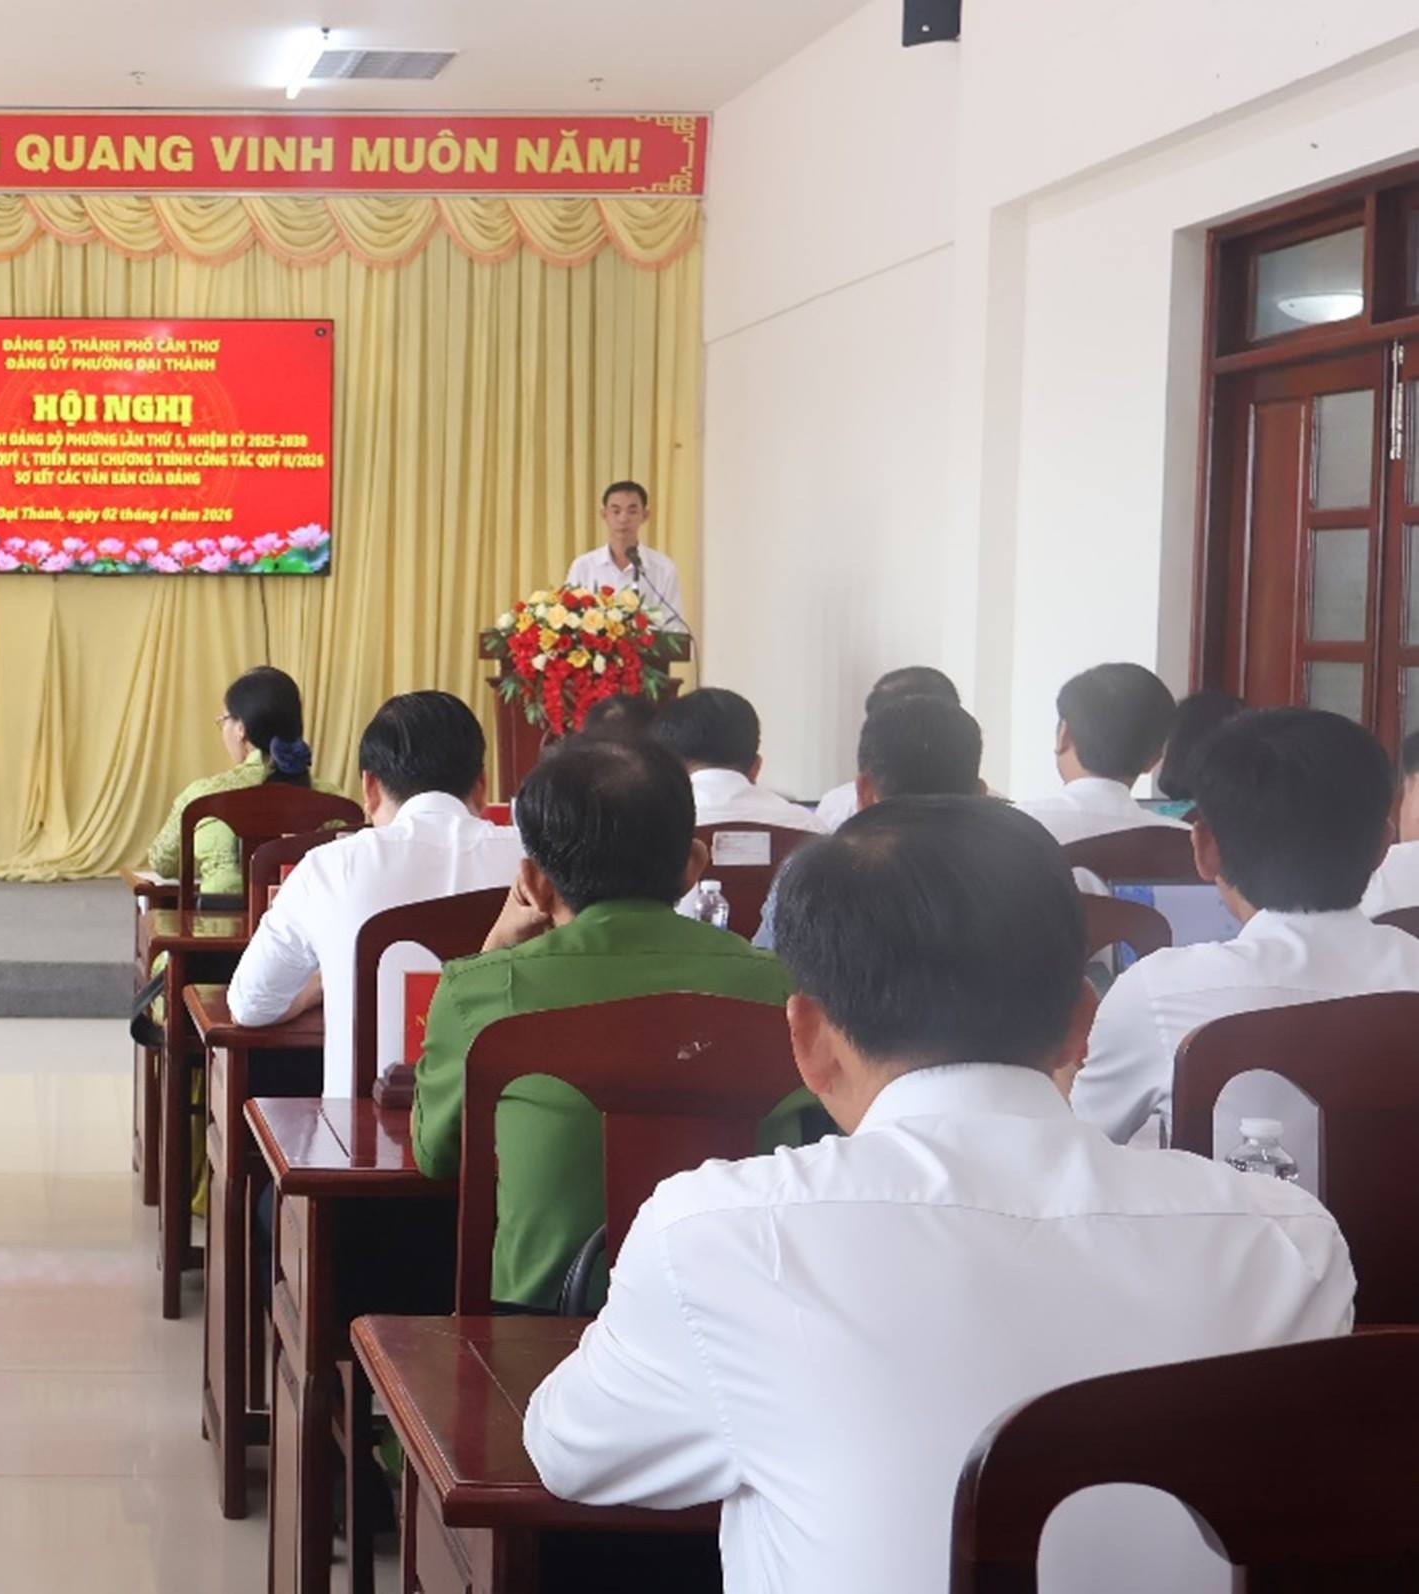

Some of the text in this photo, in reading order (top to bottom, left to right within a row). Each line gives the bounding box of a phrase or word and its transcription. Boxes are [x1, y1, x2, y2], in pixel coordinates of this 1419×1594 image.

[15, 134, 193, 172] QUANG
[211, 136, 333, 171] VINH
[351, 130, 497, 173] MUÔN
[515, 129, 641, 173] NĂM!
[2, 335, 220, 354] ĐẢNG BỘ THÀNH PHỐ CẦN THƠ
[5, 354, 47, 371] ĐẢNG
[72, 355, 133, 371] PHƯỜNG
[135, 357, 161, 373] ĐẠI
[163, 355, 216, 372] THÀNH
[33, 388, 193, 427] HỘI NGHỊ
[9, 430, 44, 446] ĐẢNG
[46, 431, 63, 449] BỘ
[66, 430, 117, 446] PHƯỜNG
[120, 430, 145, 447] LẦN
[146, 431, 173, 447] THỨ
[188, 430, 228, 450] NHIỆM
[247, 433, 308, 448] 2025-2030
[32, 446, 67, 467] TRIỂN
[70, 452, 99, 467] KHAI
[101, 451, 153, 467] CHƯƠNG
[155, 449, 192, 467] TRÌNH
[194, 449, 229, 467] CÔNG
[231, 449, 254, 467] TÁC
[256, 449, 281, 468] QUÝ
[15, 467, 201, 485] SƠ KẾT CÁC VĂN BẢN CỦA ĐẢNG
[21, 505, 64, 522] Thành,
[67, 506, 100, 525] ngày
[101, 507, 117, 521] 02
[119, 506, 158, 524] tháng
[159, 507, 169, 521] 4
[171, 507, 200, 522] năm
[202, 507, 233, 522] 2026
